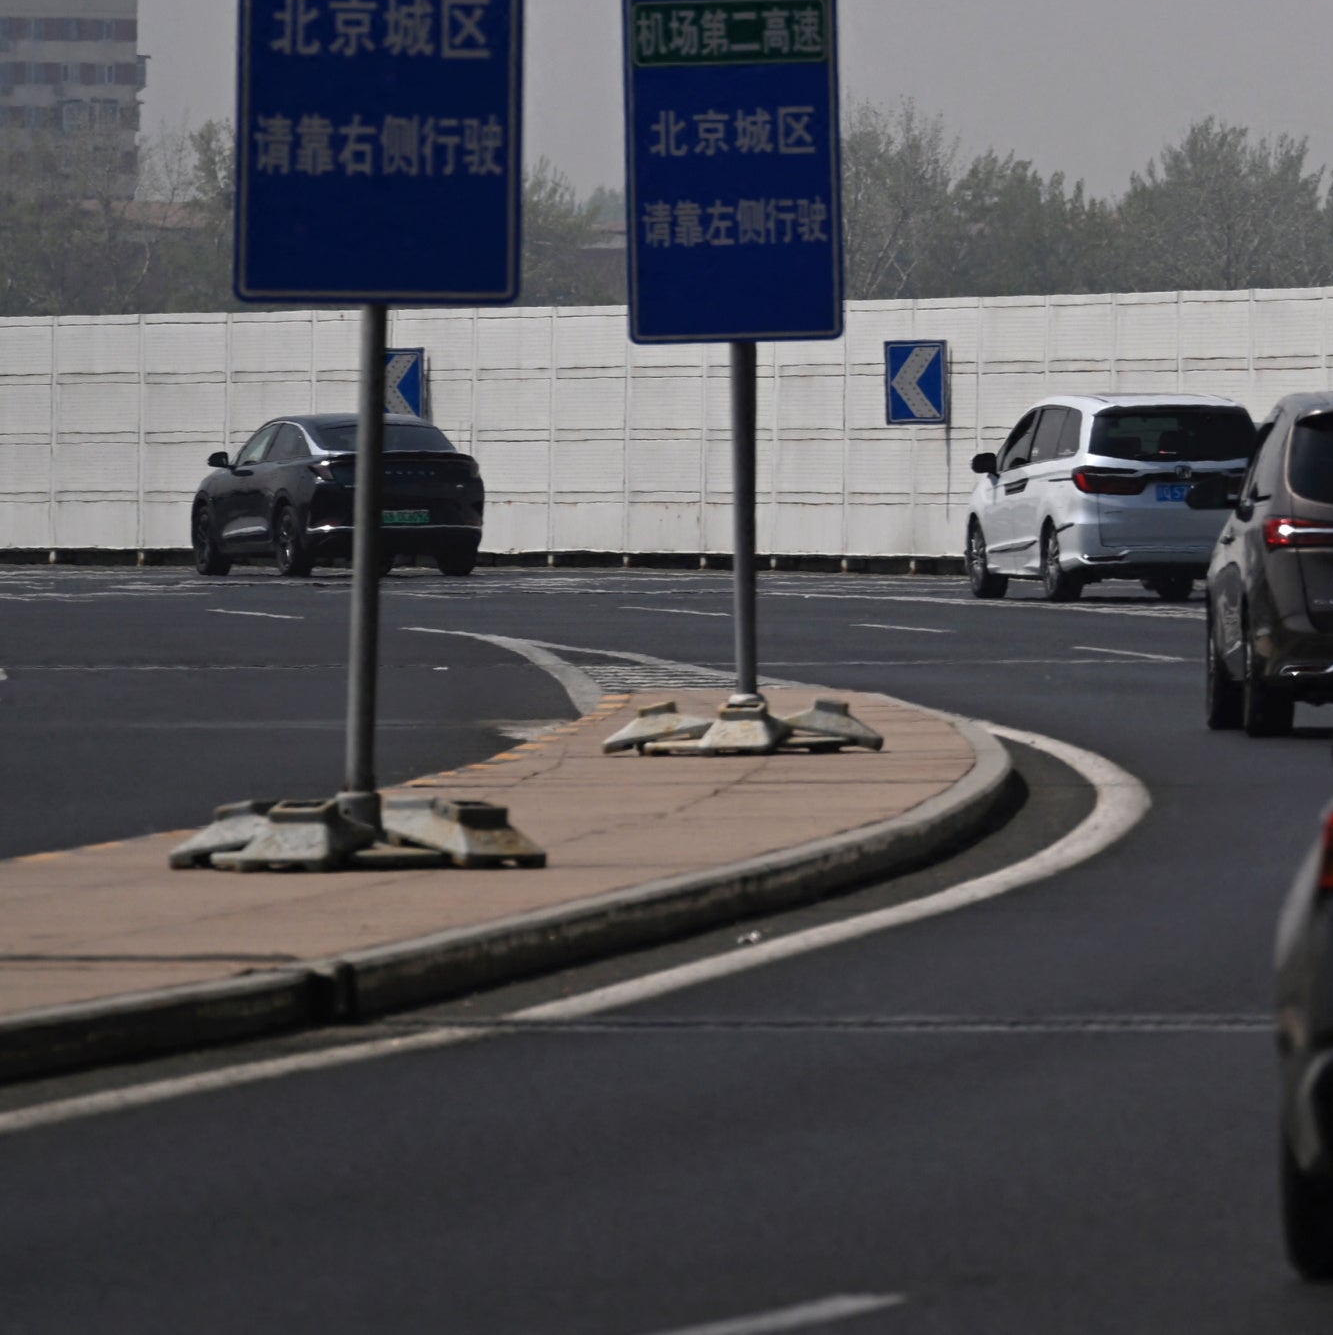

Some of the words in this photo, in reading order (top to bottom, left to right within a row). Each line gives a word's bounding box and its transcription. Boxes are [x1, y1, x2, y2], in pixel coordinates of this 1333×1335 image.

[636, 6, 823, 56] 机场第二高速
[253, 113, 504, 176] 请靠右侧行驶
[650, 105, 816, 157] 北京城区
[641, 195, 828, 248] 请靠左侧行驶
